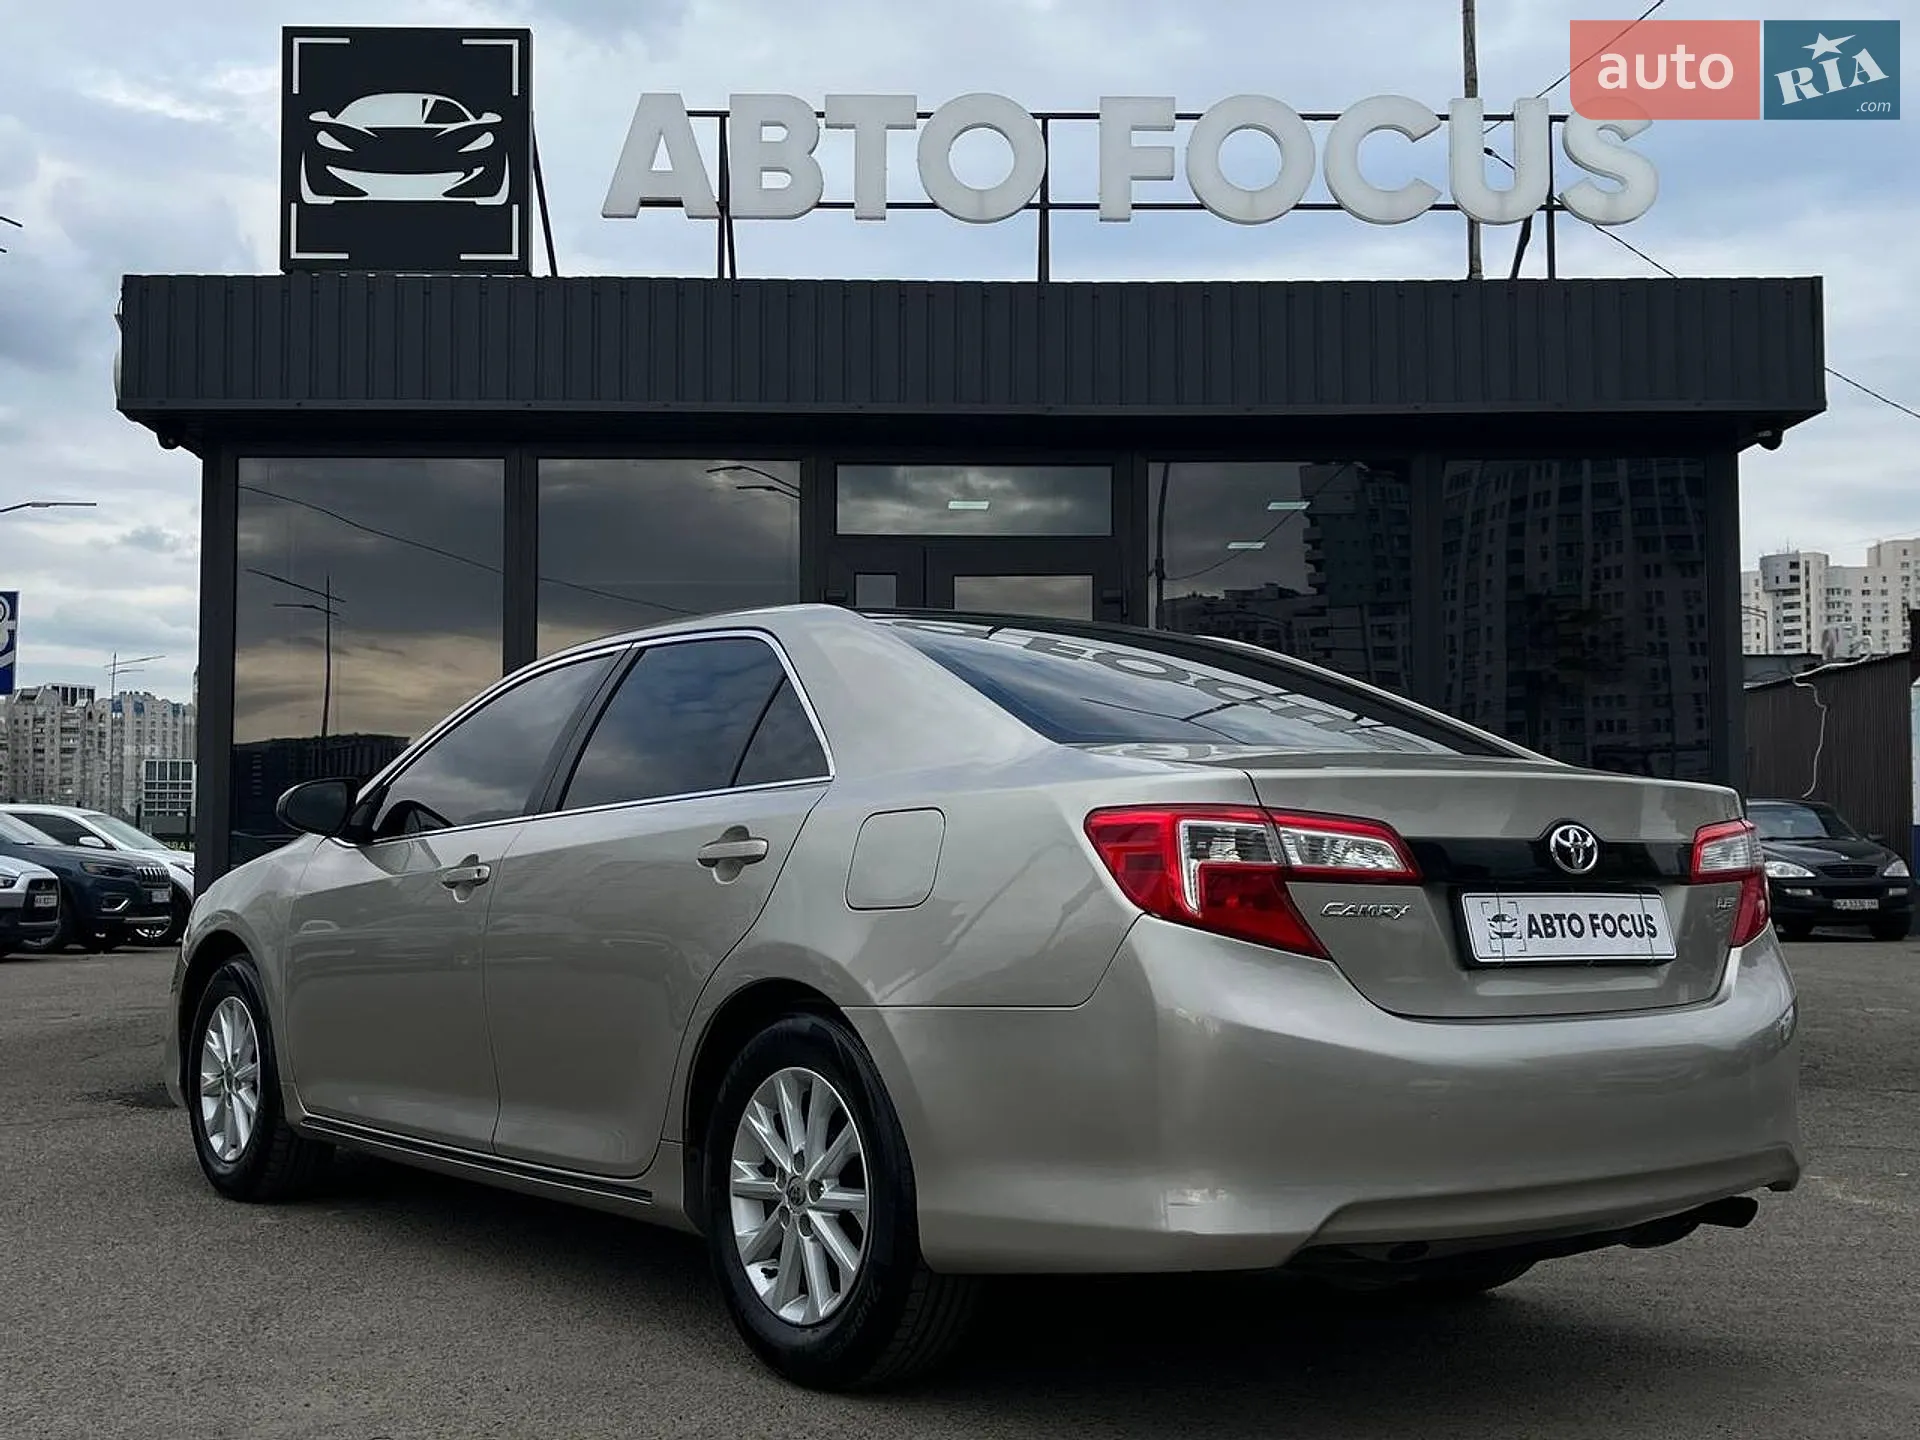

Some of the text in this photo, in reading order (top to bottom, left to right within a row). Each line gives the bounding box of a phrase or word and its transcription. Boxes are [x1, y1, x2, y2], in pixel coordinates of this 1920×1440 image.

[1098, 94, 1659, 226] FOCUS
[1320, 901, 1411, 920] CAMRY
[1588, 913, 1658, 939] FOCUS
